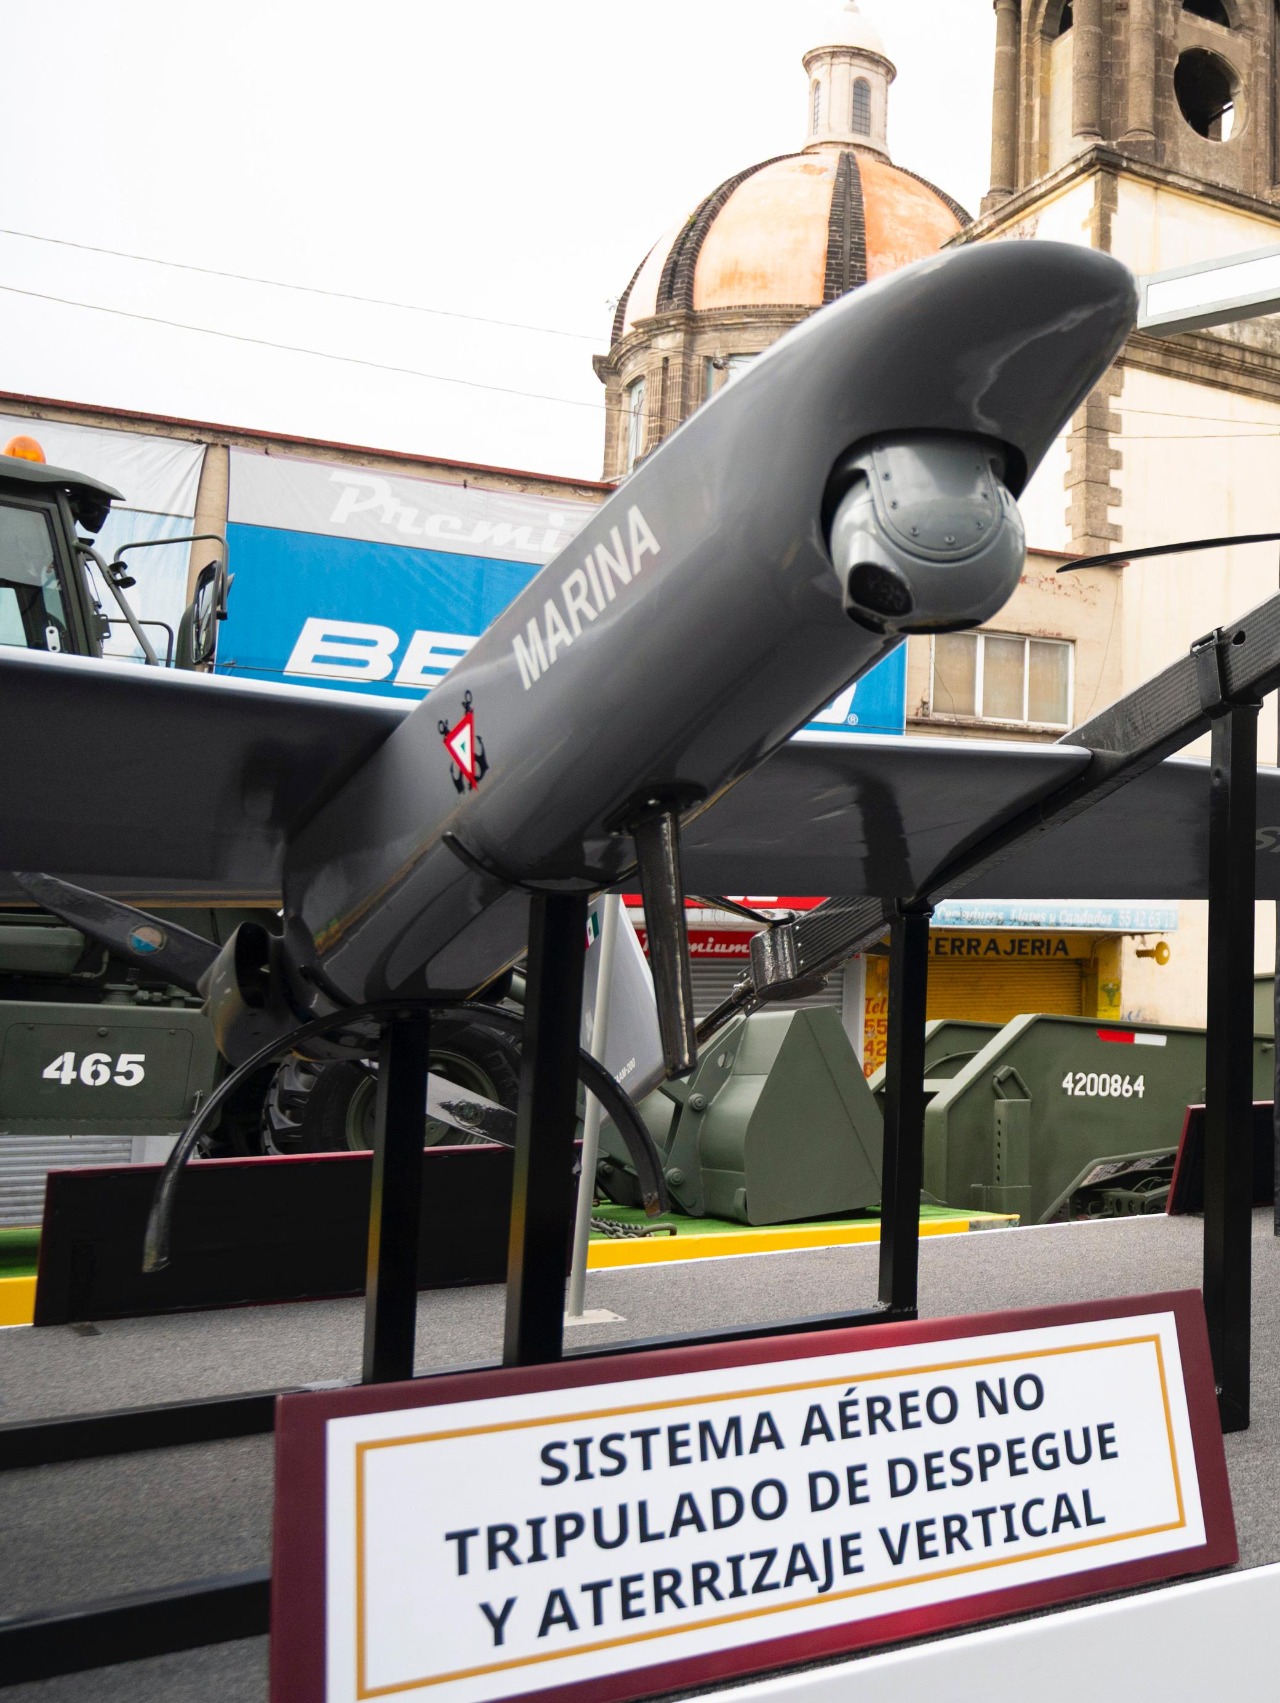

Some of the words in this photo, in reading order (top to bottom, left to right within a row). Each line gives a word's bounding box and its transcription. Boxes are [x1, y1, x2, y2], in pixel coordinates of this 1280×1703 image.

[511, 504, 662, 691] MARINA
[1059, 908, 1113, 925] Candados
[1119, 909, 1132, 927] 55
[928, 936, 1070, 957] ERRAJERIA
[864, 1018, 888, 1036] 55
[864, 1039, 887, 1057] 42
[42, 1051, 147, 1087] 465
[1061, 1071, 1146, 1099] 4200864
[537, 1411, 786, 1487] SISTEMA
[800, 1384, 960, 1448] AÉREO
[975, 1373, 1045, 1419] NO
[445, 1479, 790, 1577] TRIPULADO
[808, 1463, 872, 1514] DE
[887, 1421, 1119, 1499] DESPEGUE
[479, 1598, 517, 1648] Y
[537, 1532, 865, 1638] ATERRIZAJE
[879, 1488, 1108, 1567] VERTICAL
